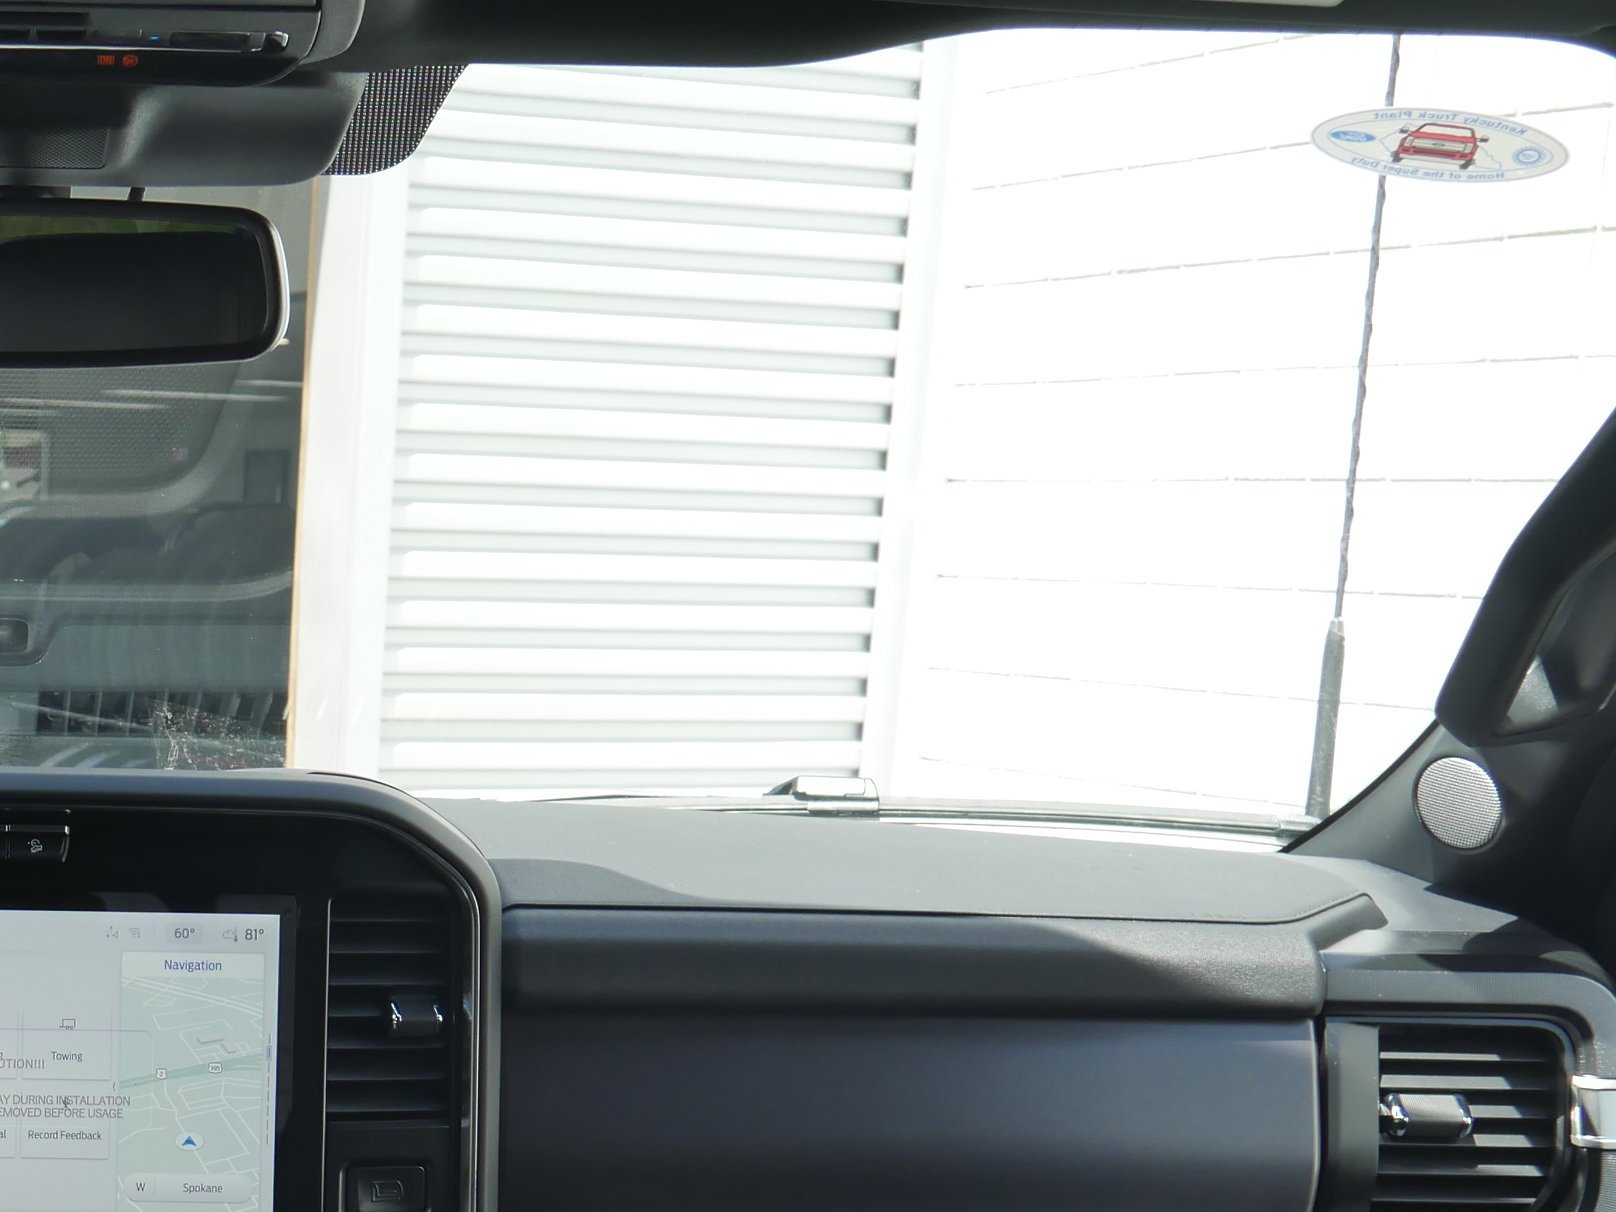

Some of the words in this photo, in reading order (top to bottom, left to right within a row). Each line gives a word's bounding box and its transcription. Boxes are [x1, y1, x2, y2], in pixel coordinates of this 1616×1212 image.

[174, 928, 195, 940] 60°
[244, 928, 265, 941] 81°
[164, 959, 223, 973] Navigation
[51, 1051, 83, 1063] Towing
[13, 1095, 54, 1106] DURING
[56, 1095, 131, 1107] INSTALLATION
[44, 1108, 85, 1119] BEFORE
[88, 1108, 124, 1120] USAGE
[28, 1129, 59, 1141] Record
[60, 1129, 103, 1141] Feedback
[136, 1183, 146, 1192] W
[182, 1182, 223, 1194] Spokane
